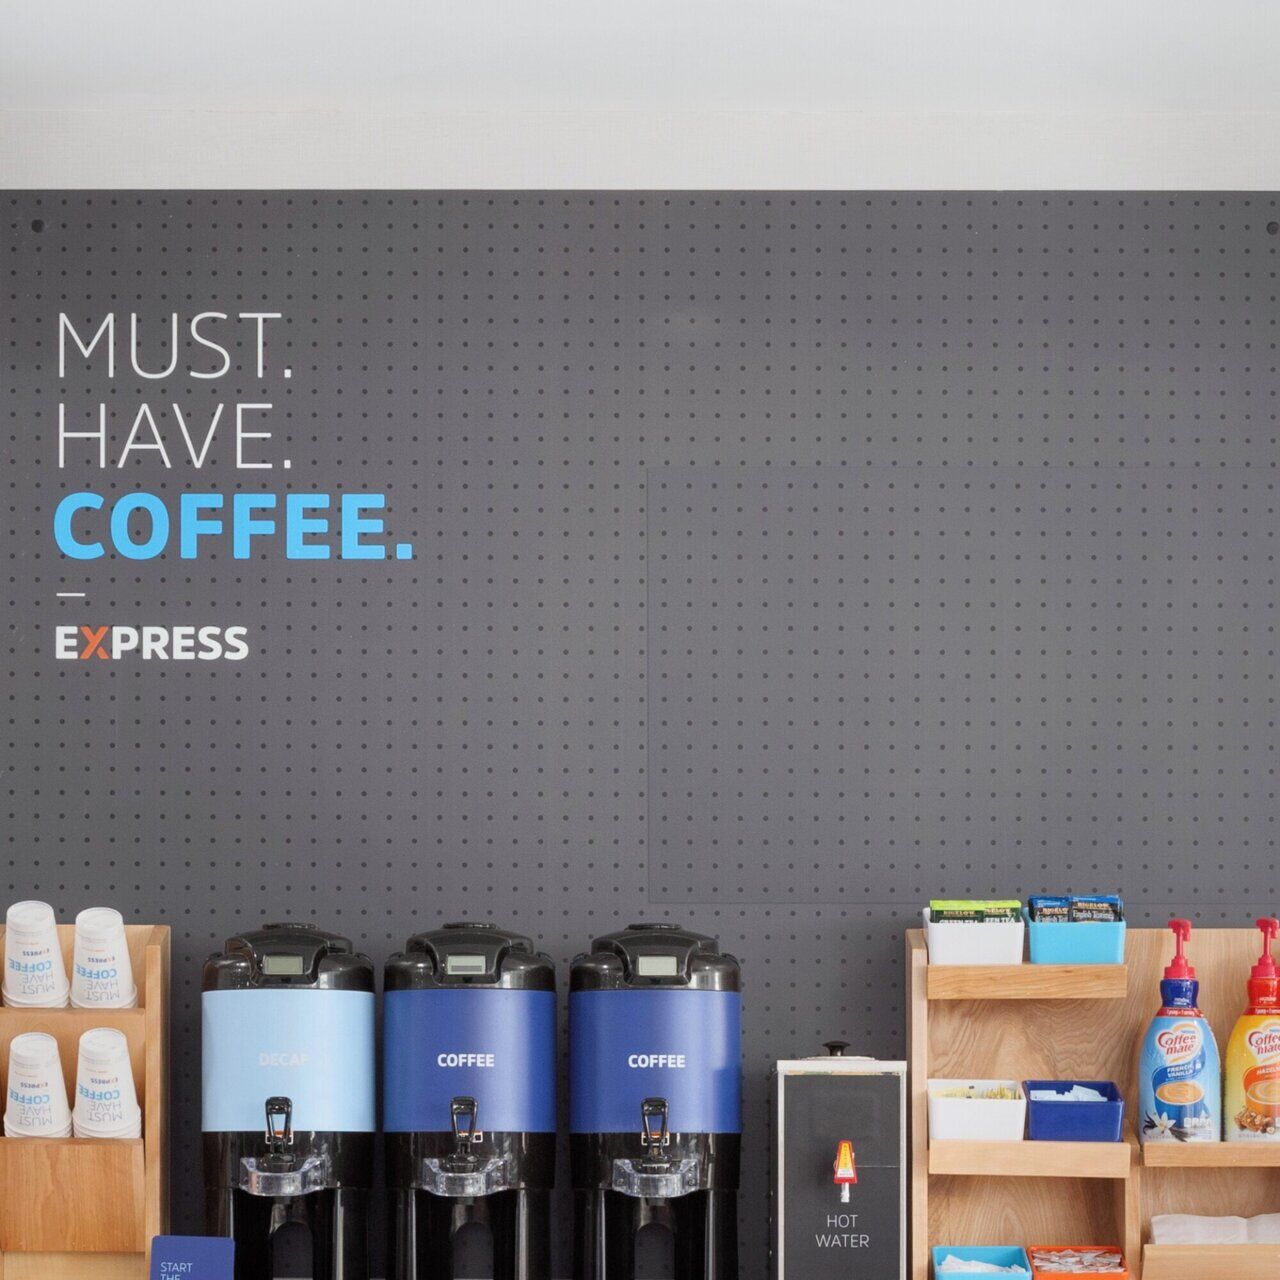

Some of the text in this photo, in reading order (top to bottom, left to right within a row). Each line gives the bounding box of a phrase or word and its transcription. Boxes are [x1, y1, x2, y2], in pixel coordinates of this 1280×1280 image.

[58, 311, 292, 379] MUST.
[58, 403, 292, 469] HAVE.
[53, 491, 413, 560] COFFEE.
[55, 625, 249, 660] EXPRESS
[1158, 1031, 1197, 1049] Coffee
[1166, 1044, 1194, 1056] mate
[259, 1052, 309, 1067] DECAF
[437, 1053, 495, 1068] COFFEE
[628, 1054, 686, 1069] COFFEE
[826, 1214, 858, 1228] HOT
[815, 1234, 870, 1248] WATER
[160, 1261, 193, 1273] START
